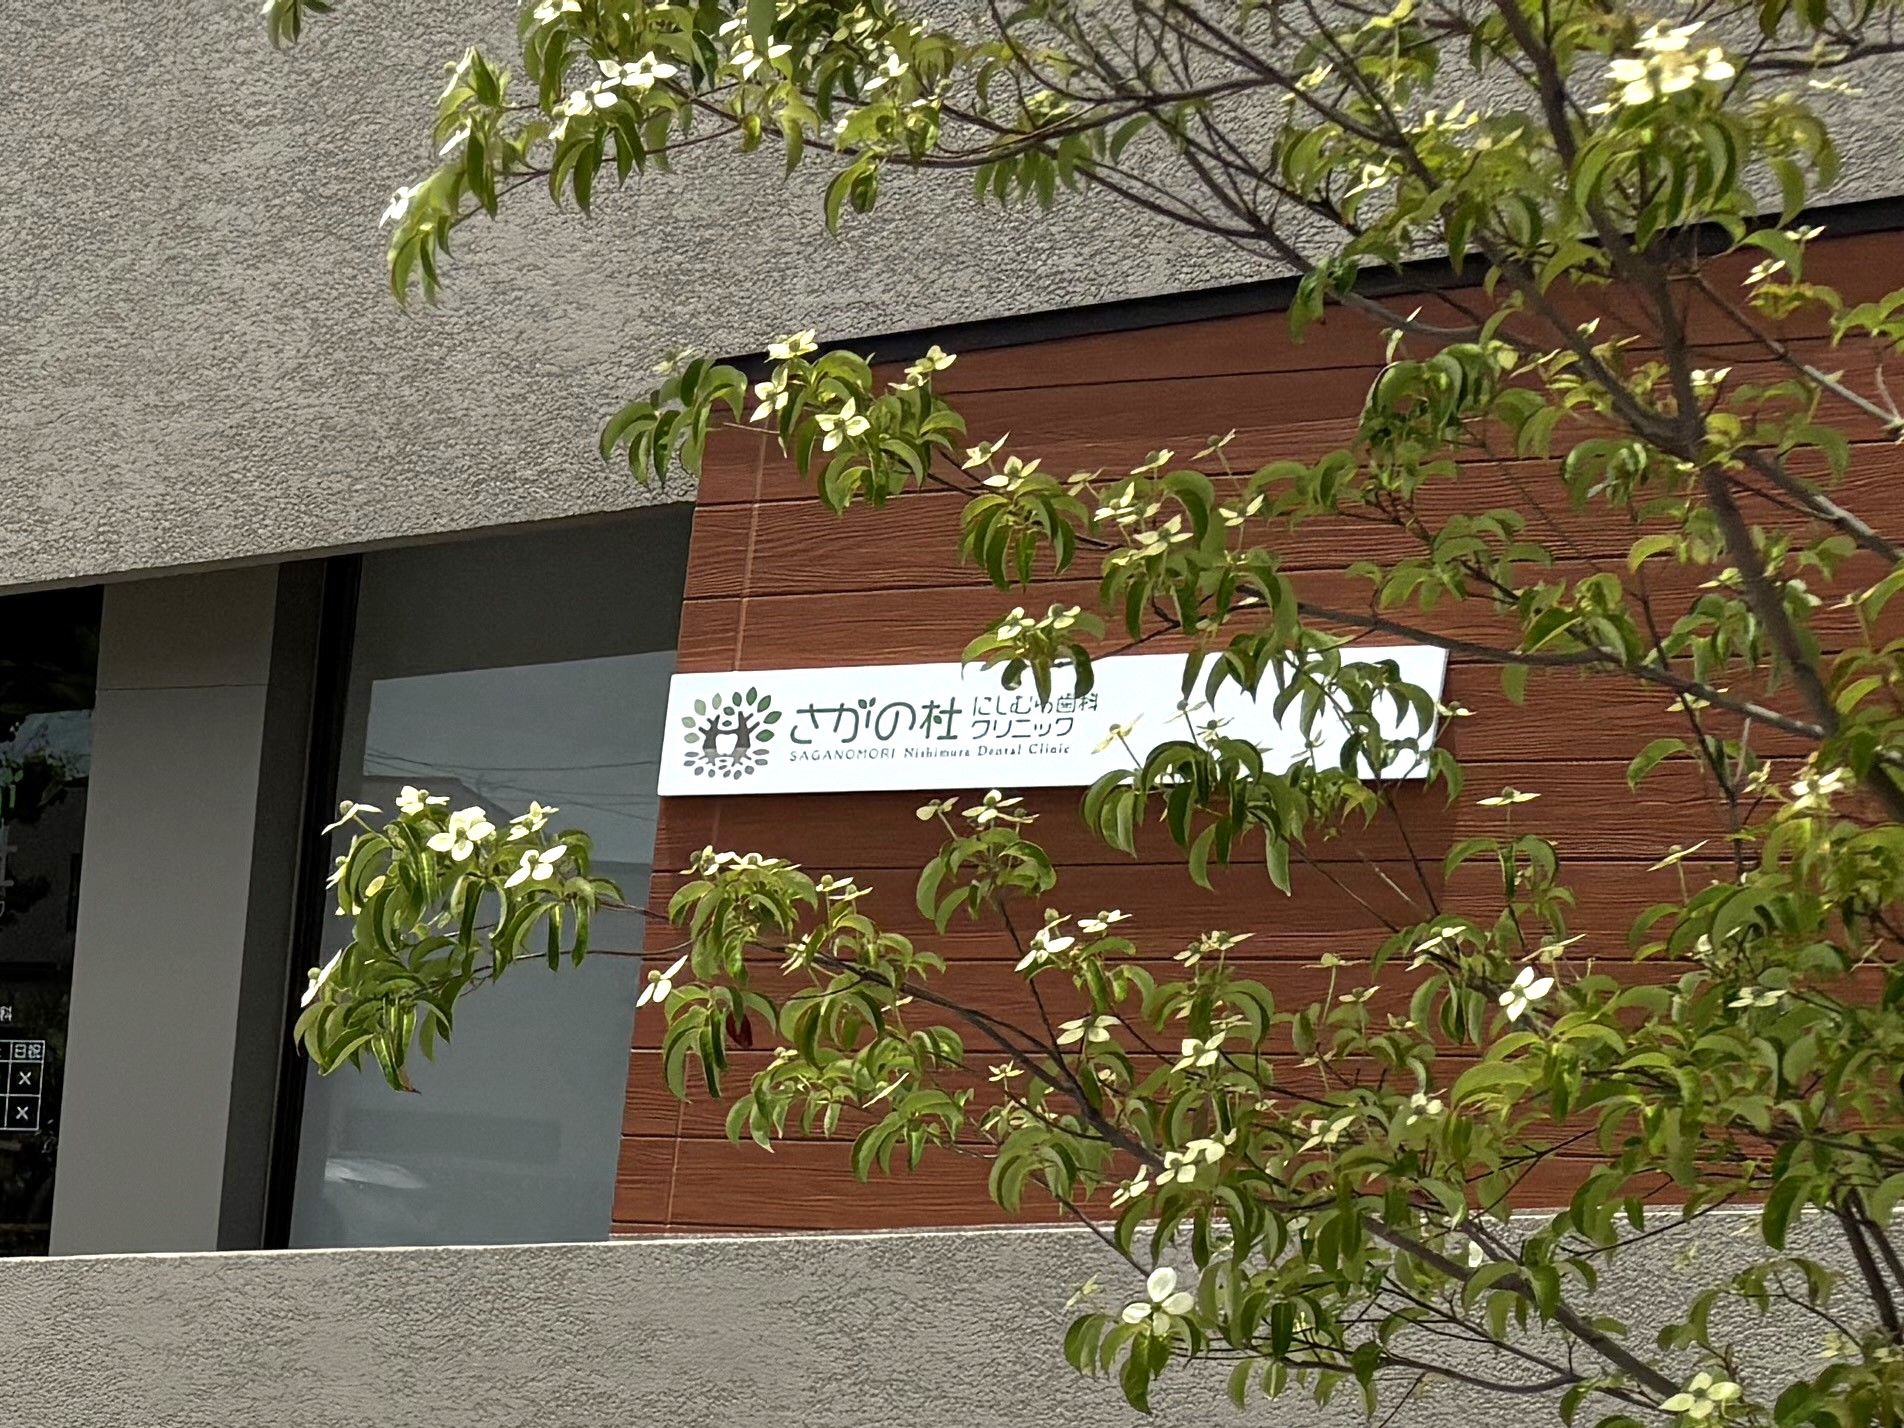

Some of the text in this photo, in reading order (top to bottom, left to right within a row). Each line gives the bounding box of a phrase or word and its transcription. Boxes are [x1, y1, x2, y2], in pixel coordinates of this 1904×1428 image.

[971, 692, 1098, 716] にしむら歯科
[789, 696, 963, 745] さがの杜
[971, 717, 1074, 740] クリニック
[789, 743, 1070, 762] SAGANOMORI Nishimura Dental Clinic
[14, 1044, 42, 1059] 日祝
